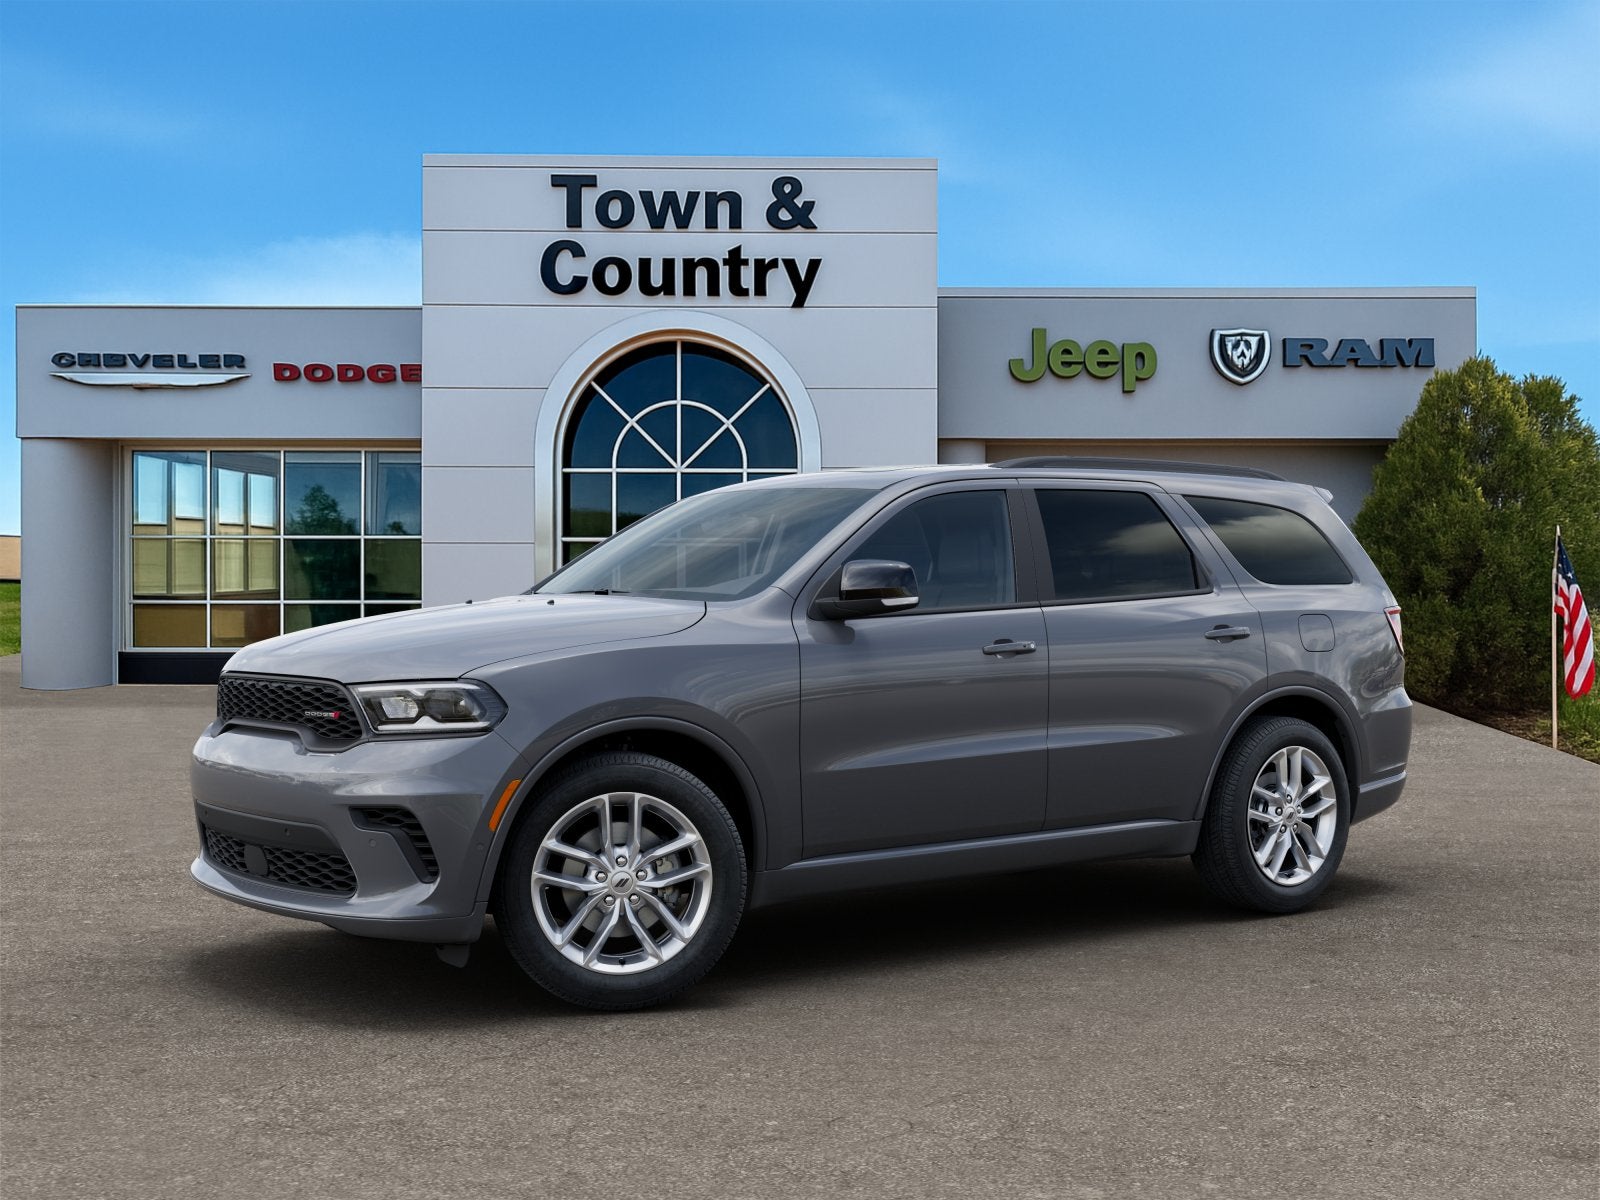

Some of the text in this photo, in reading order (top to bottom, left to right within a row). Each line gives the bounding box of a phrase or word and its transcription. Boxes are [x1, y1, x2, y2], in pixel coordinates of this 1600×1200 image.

[550, 174, 818, 230] Town &
[539, 239, 823, 308] Country
[273, 363, 422, 383] DODGE
[1009, 327, 1157, 392] Jeep
[1282, 337, 1436, 368] RAM
